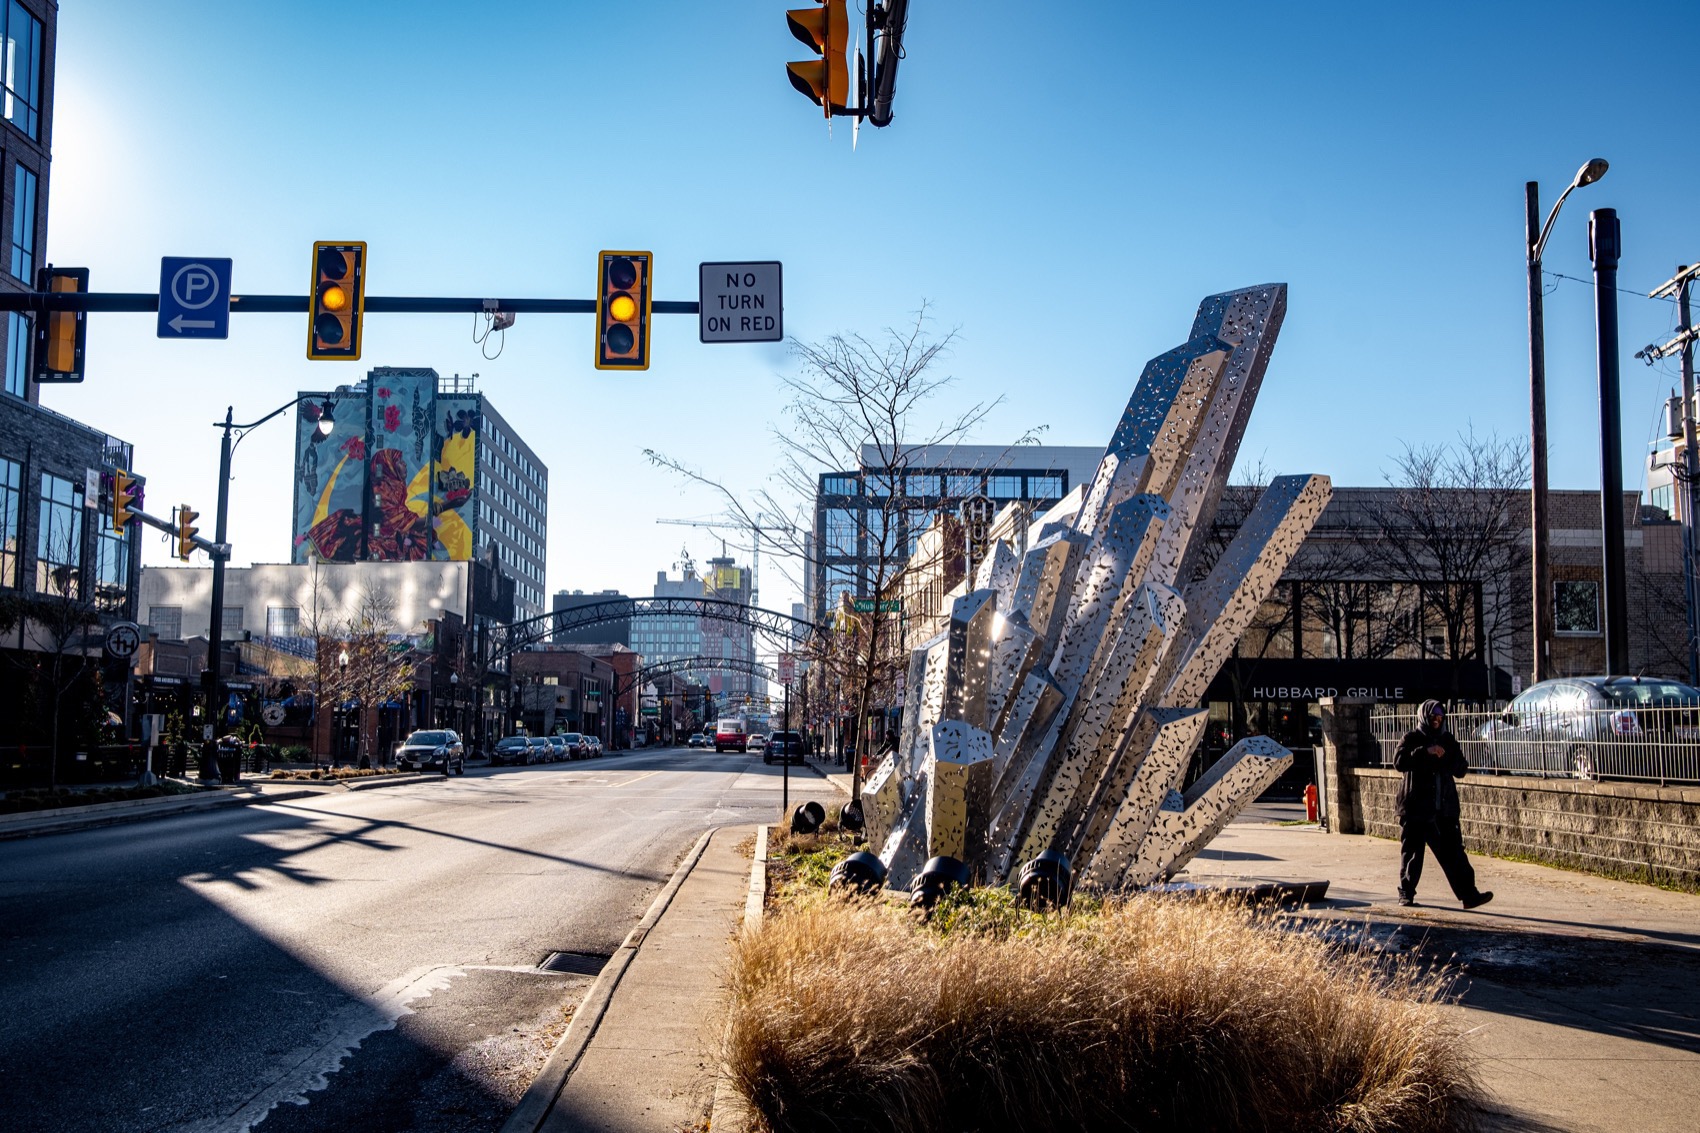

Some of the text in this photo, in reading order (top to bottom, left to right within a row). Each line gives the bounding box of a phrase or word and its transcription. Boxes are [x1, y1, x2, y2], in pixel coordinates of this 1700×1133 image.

[186, 273, 209, 300] P
[726, 273, 756, 288] NO
[718, 294, 764, 310] TURN
[707, 316, 775, 332] ON RED
[1253, 687, 1404, 699] HUBBARD GRILLE
